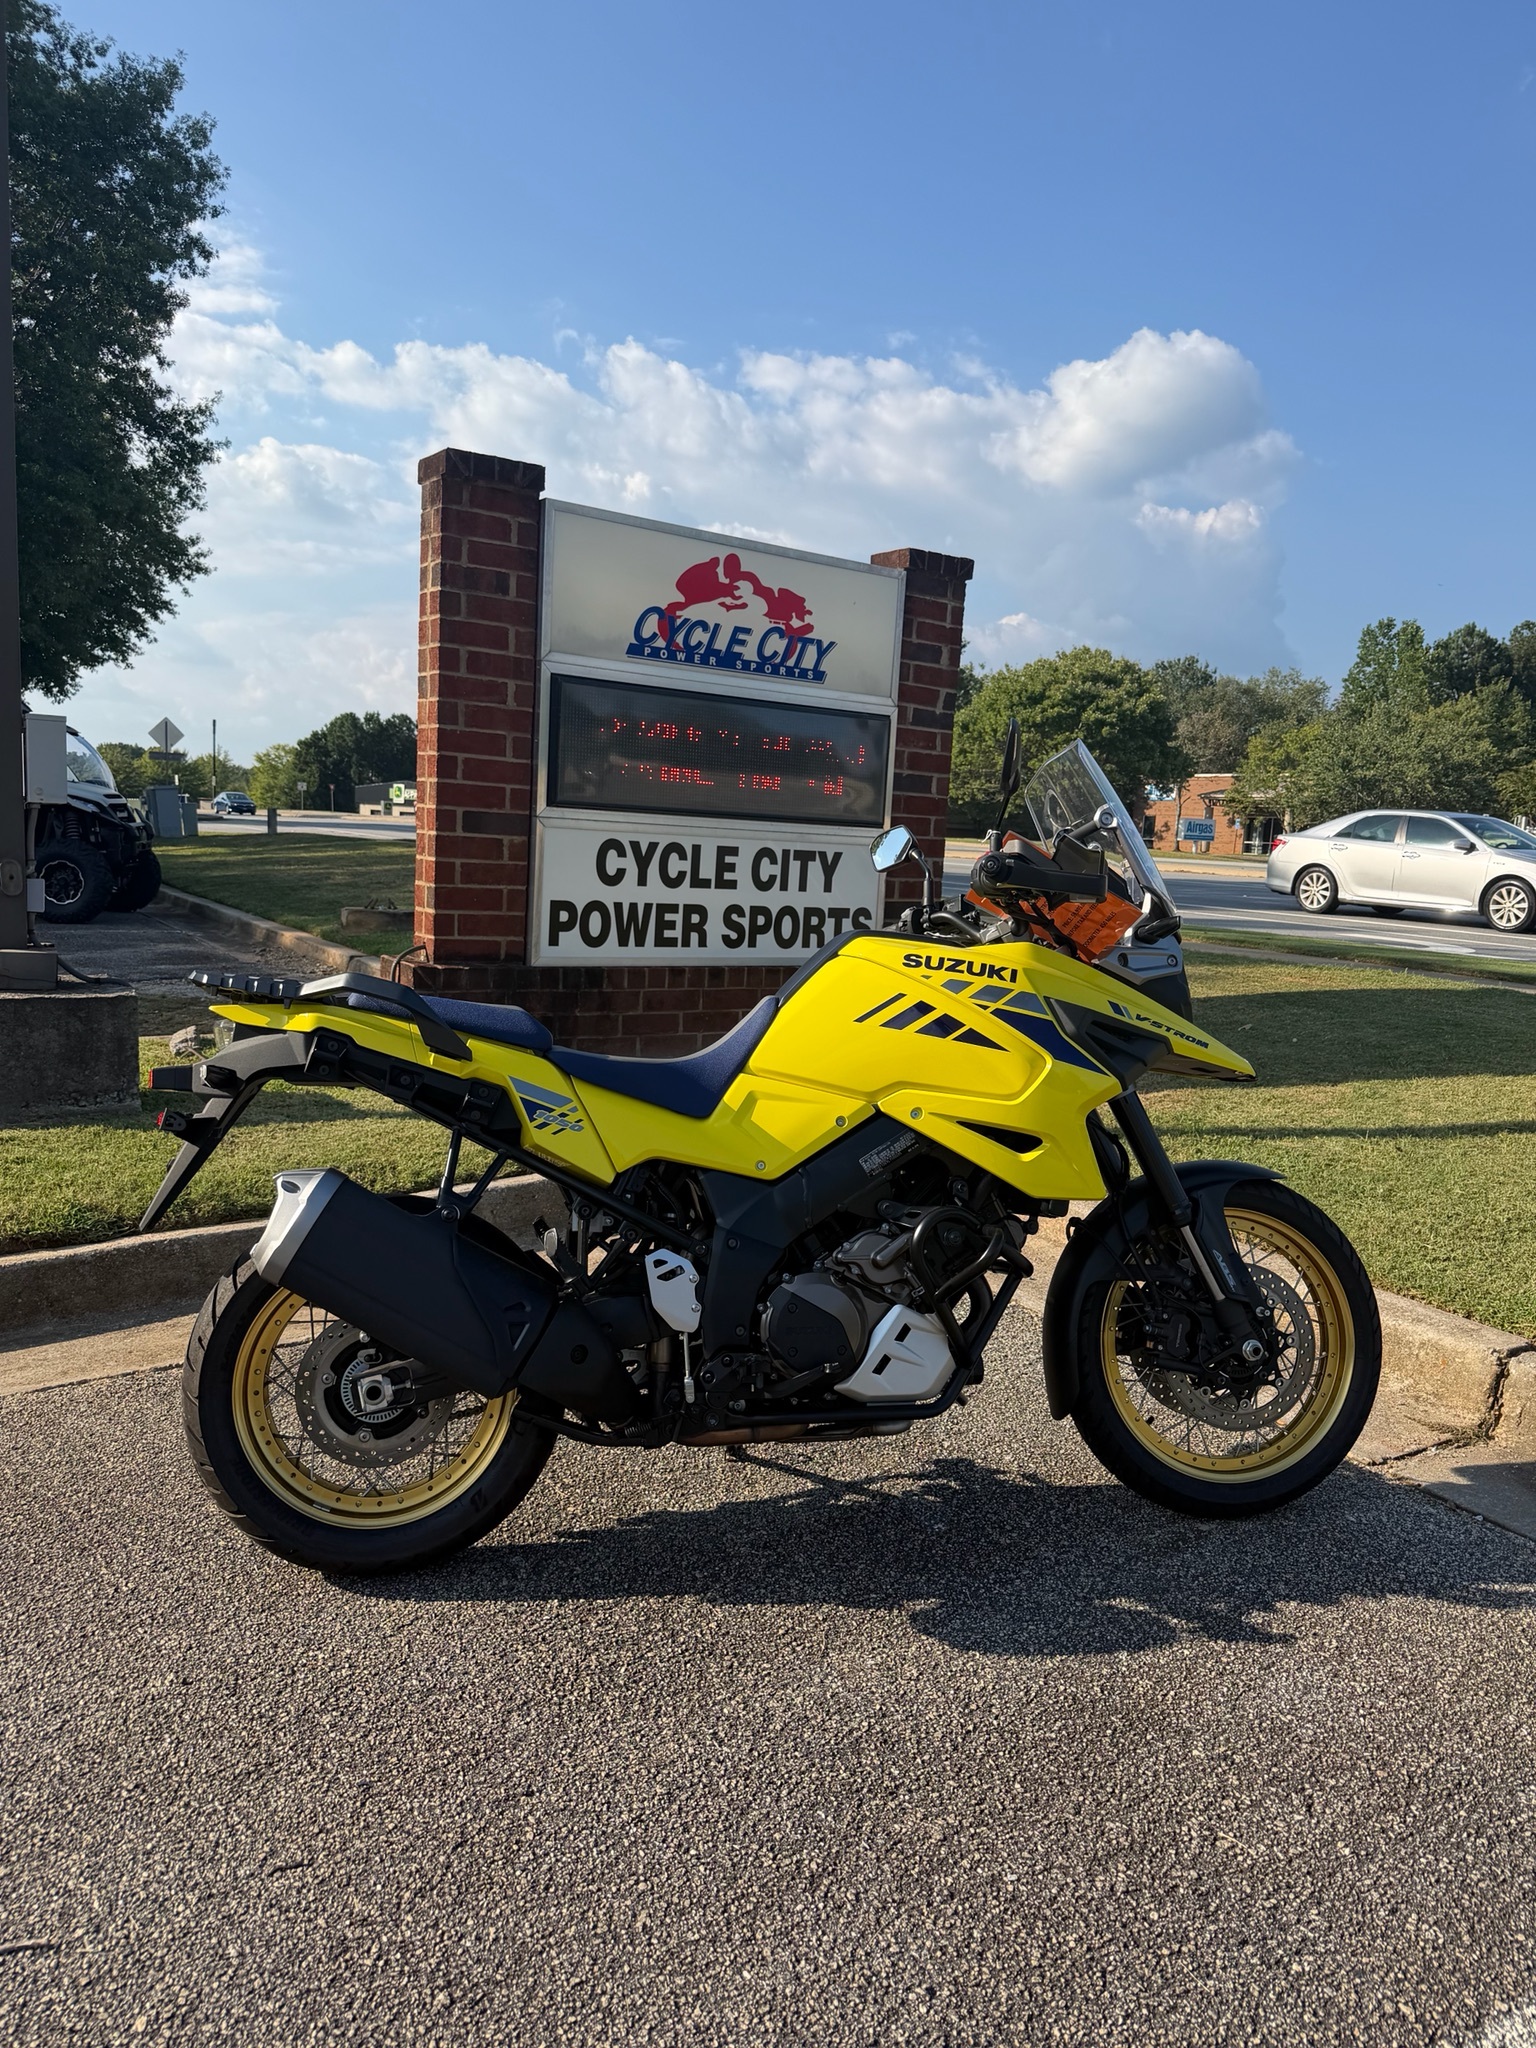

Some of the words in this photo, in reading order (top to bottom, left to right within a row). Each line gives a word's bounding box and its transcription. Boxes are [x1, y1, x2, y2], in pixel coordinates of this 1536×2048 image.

[633, 606, 753, 657] CYCLE
[756, 626, 838, 671] CITY
[643, 647, 717, 666] POWER
[735, 660, 814, 679] SPORTS
[1186, 820, 1213, 834] Airgas
[595, 838, 739, 890] CYCLE
[751, 846, 843, 893] CITY
[548, 899, 709, 949] POWER
[902, 953, 1018, 984] SUZUKI
[1135, 1013, 1210, 1049] V-STROM
[533, 1110, 585, 1132] 1050
